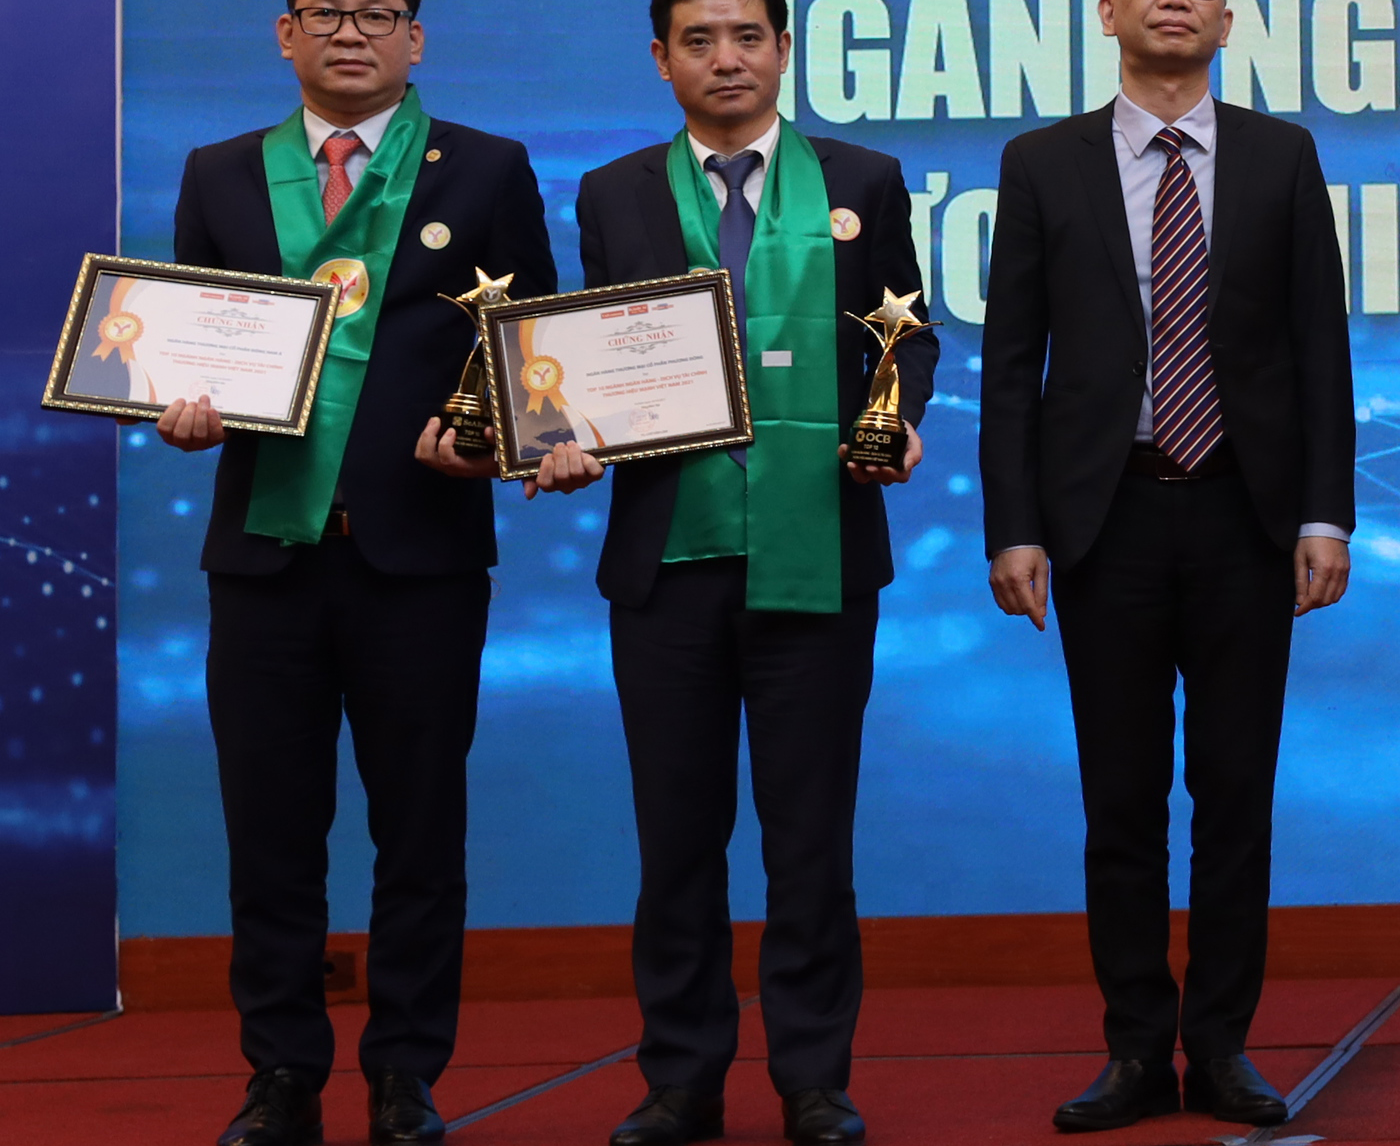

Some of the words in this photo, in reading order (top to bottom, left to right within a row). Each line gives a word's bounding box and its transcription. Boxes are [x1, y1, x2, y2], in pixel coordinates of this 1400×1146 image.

[607, 333, 643, 346] CHỨNG
[646, 328, 675, 342] NHẬN
[865, 431, 891, 444] OCB
